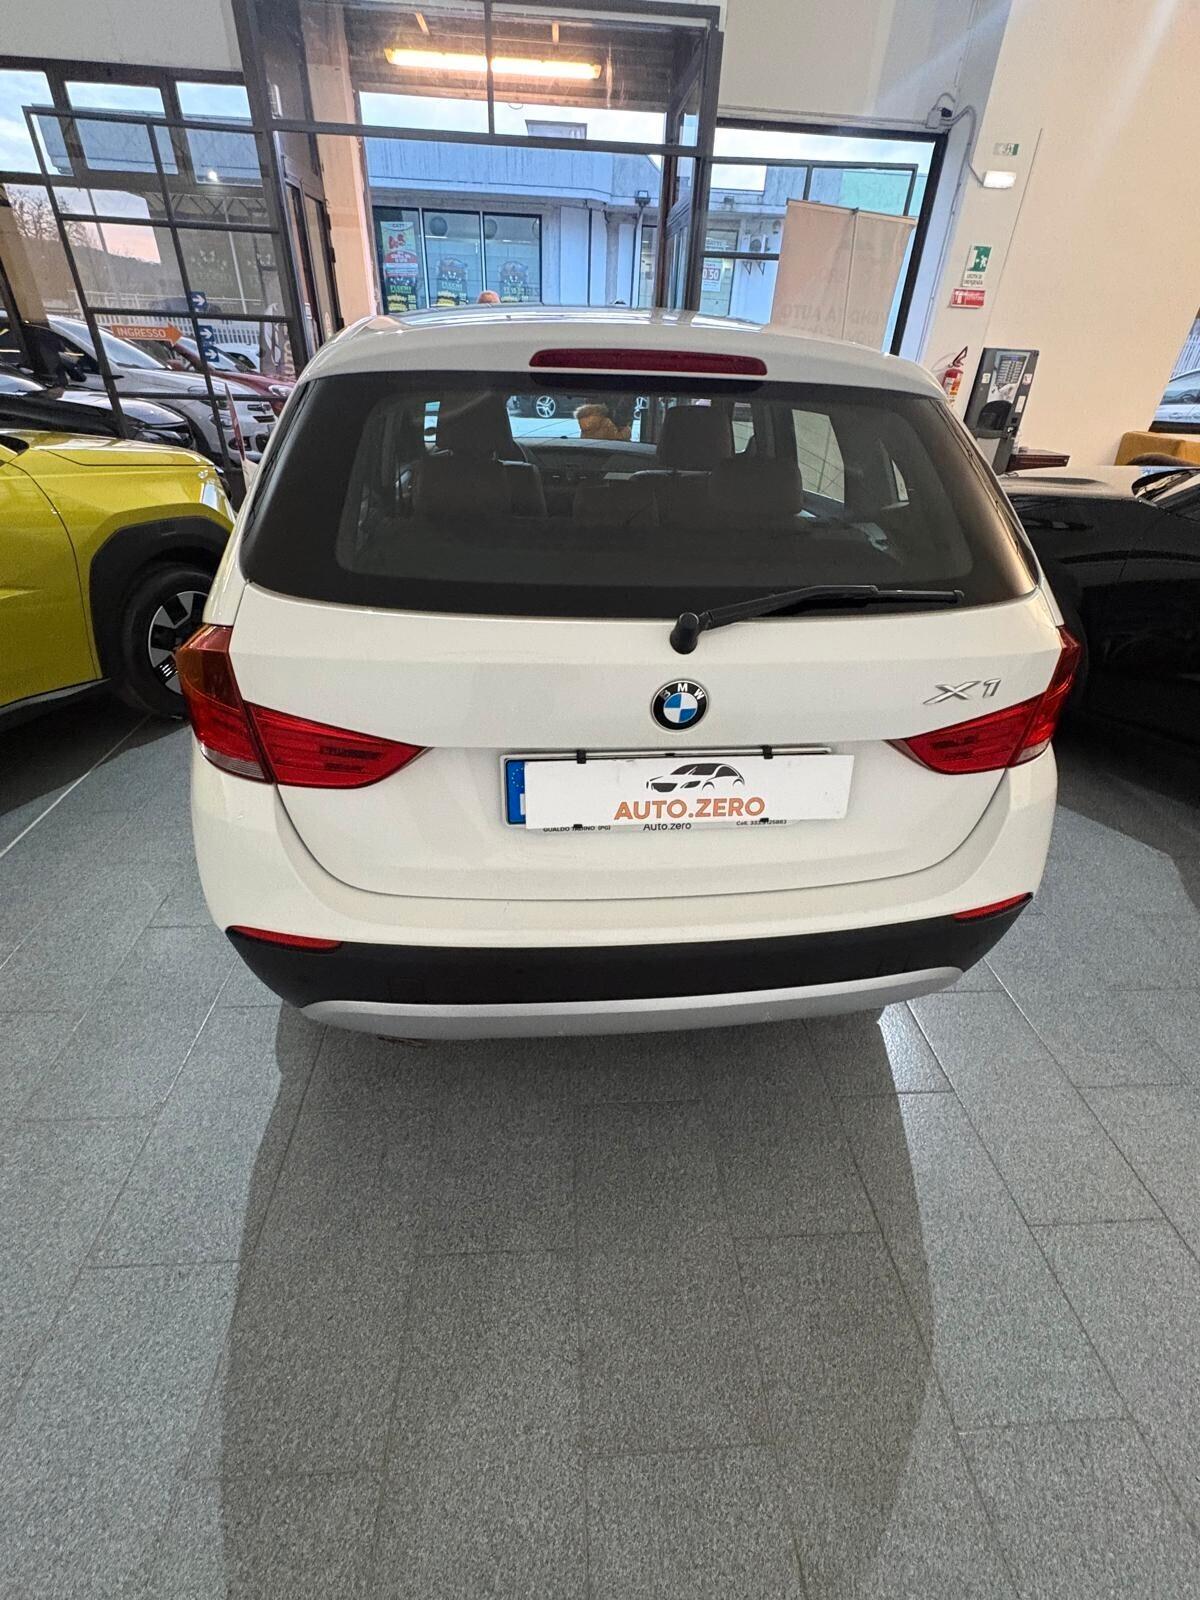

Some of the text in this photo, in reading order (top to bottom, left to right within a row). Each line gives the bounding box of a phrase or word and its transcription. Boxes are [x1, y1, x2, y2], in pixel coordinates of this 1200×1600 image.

[116, 327, 167, 338] INGRESSO
[658, 682, 705, 701] BMW
[922, 677, 1002, 705] X1
[613, 796, 766, 822] AUTO.ZERO
[643, 822, 692, 832] Auto.zero
